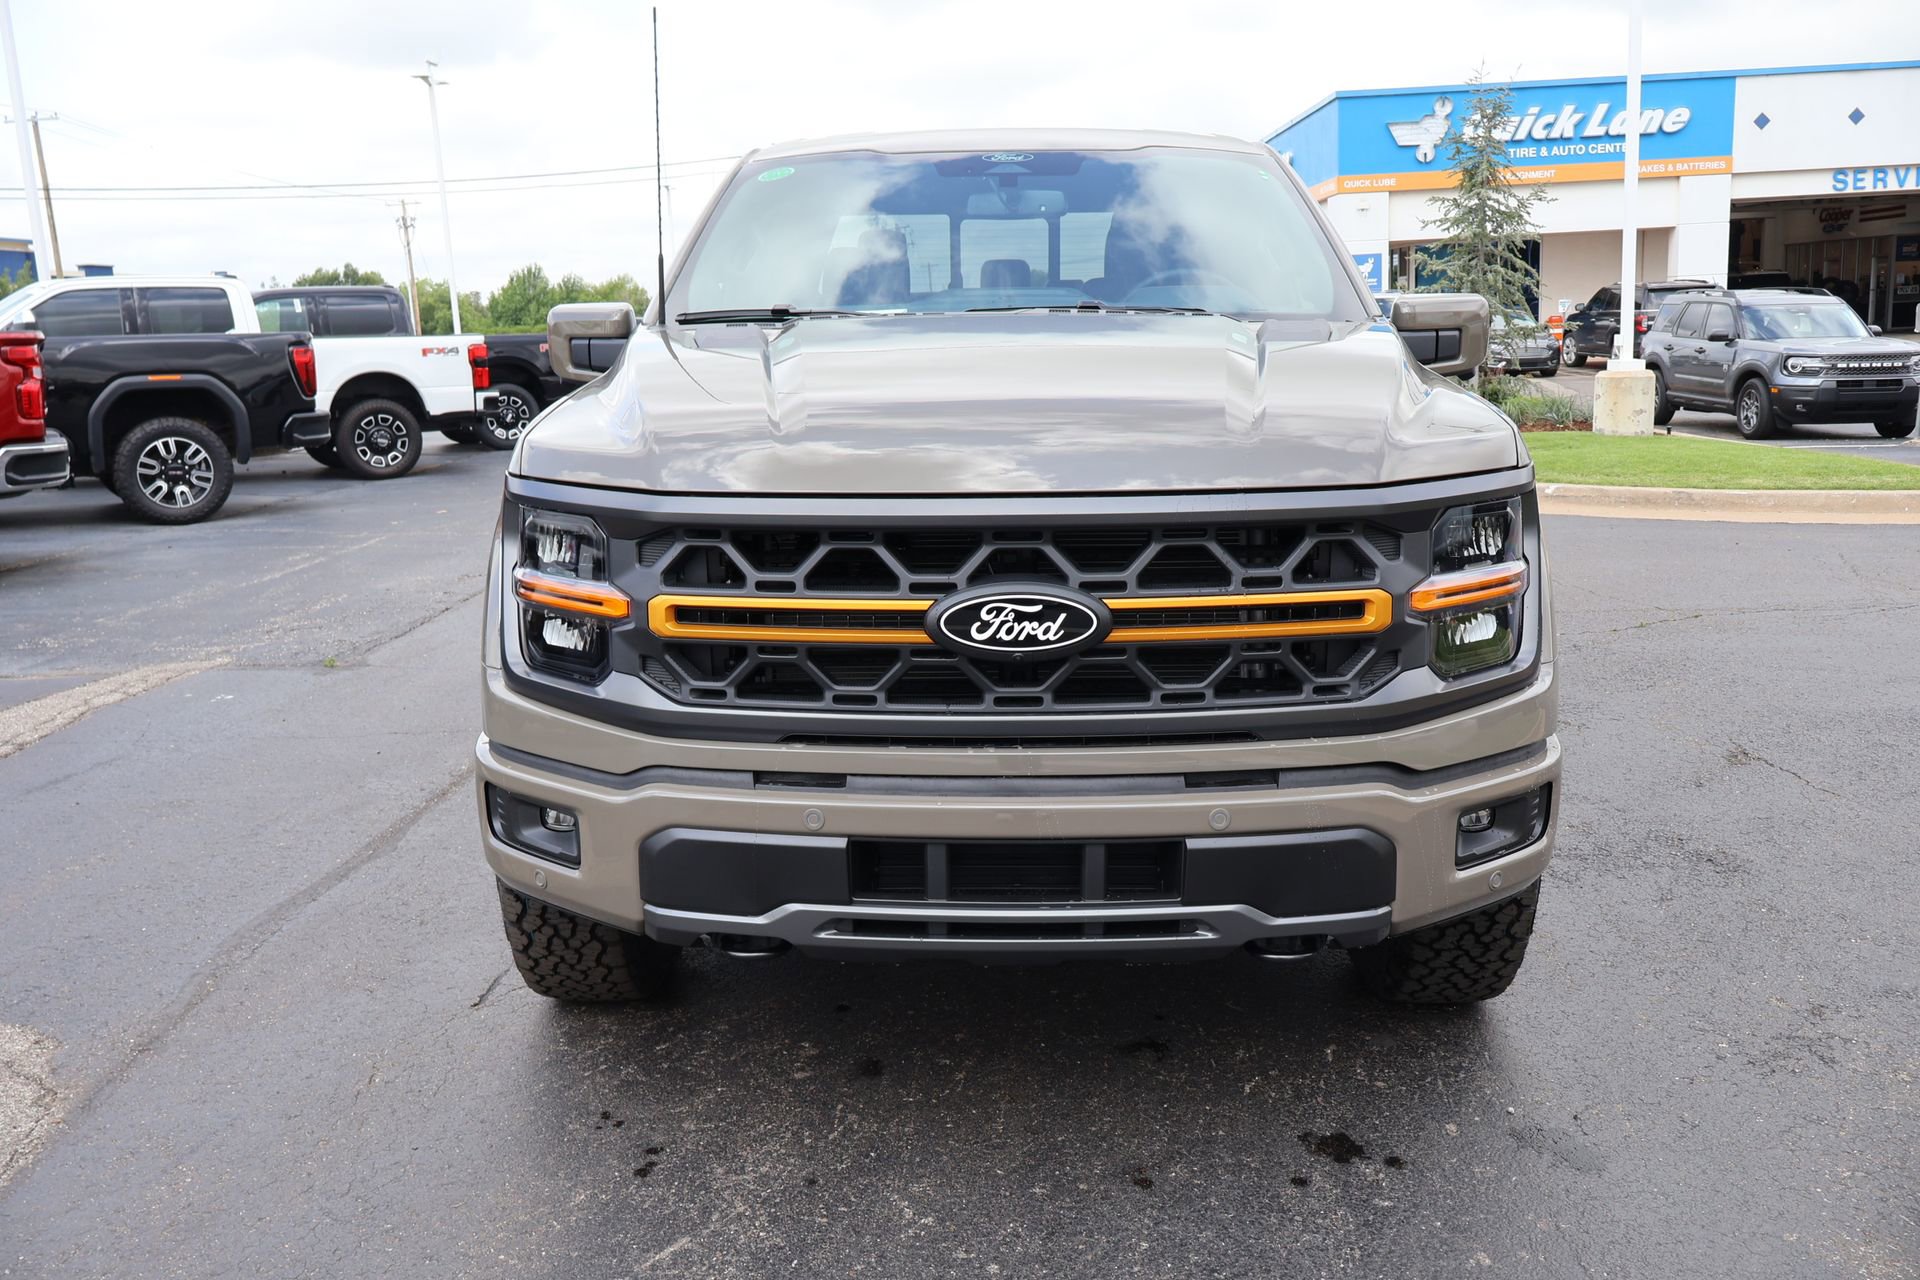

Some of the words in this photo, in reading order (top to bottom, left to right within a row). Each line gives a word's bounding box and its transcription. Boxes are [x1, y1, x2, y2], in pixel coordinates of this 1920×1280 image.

[1508, 148, 1537, 158] TIRE
[1540, 147, 1549, 157] &
[1551, 144, 1586, 156] AUTO
[1588, 142, 1627, 155] CENTE
[1667, 163, 1674, 172] &
[1676, 161, 1726, 171] BATTERIES
[1373, 177, 1397, 187] LUBE
[421, 347, 459, 357] FX4
[970, 602, 1067, 641] Ford
